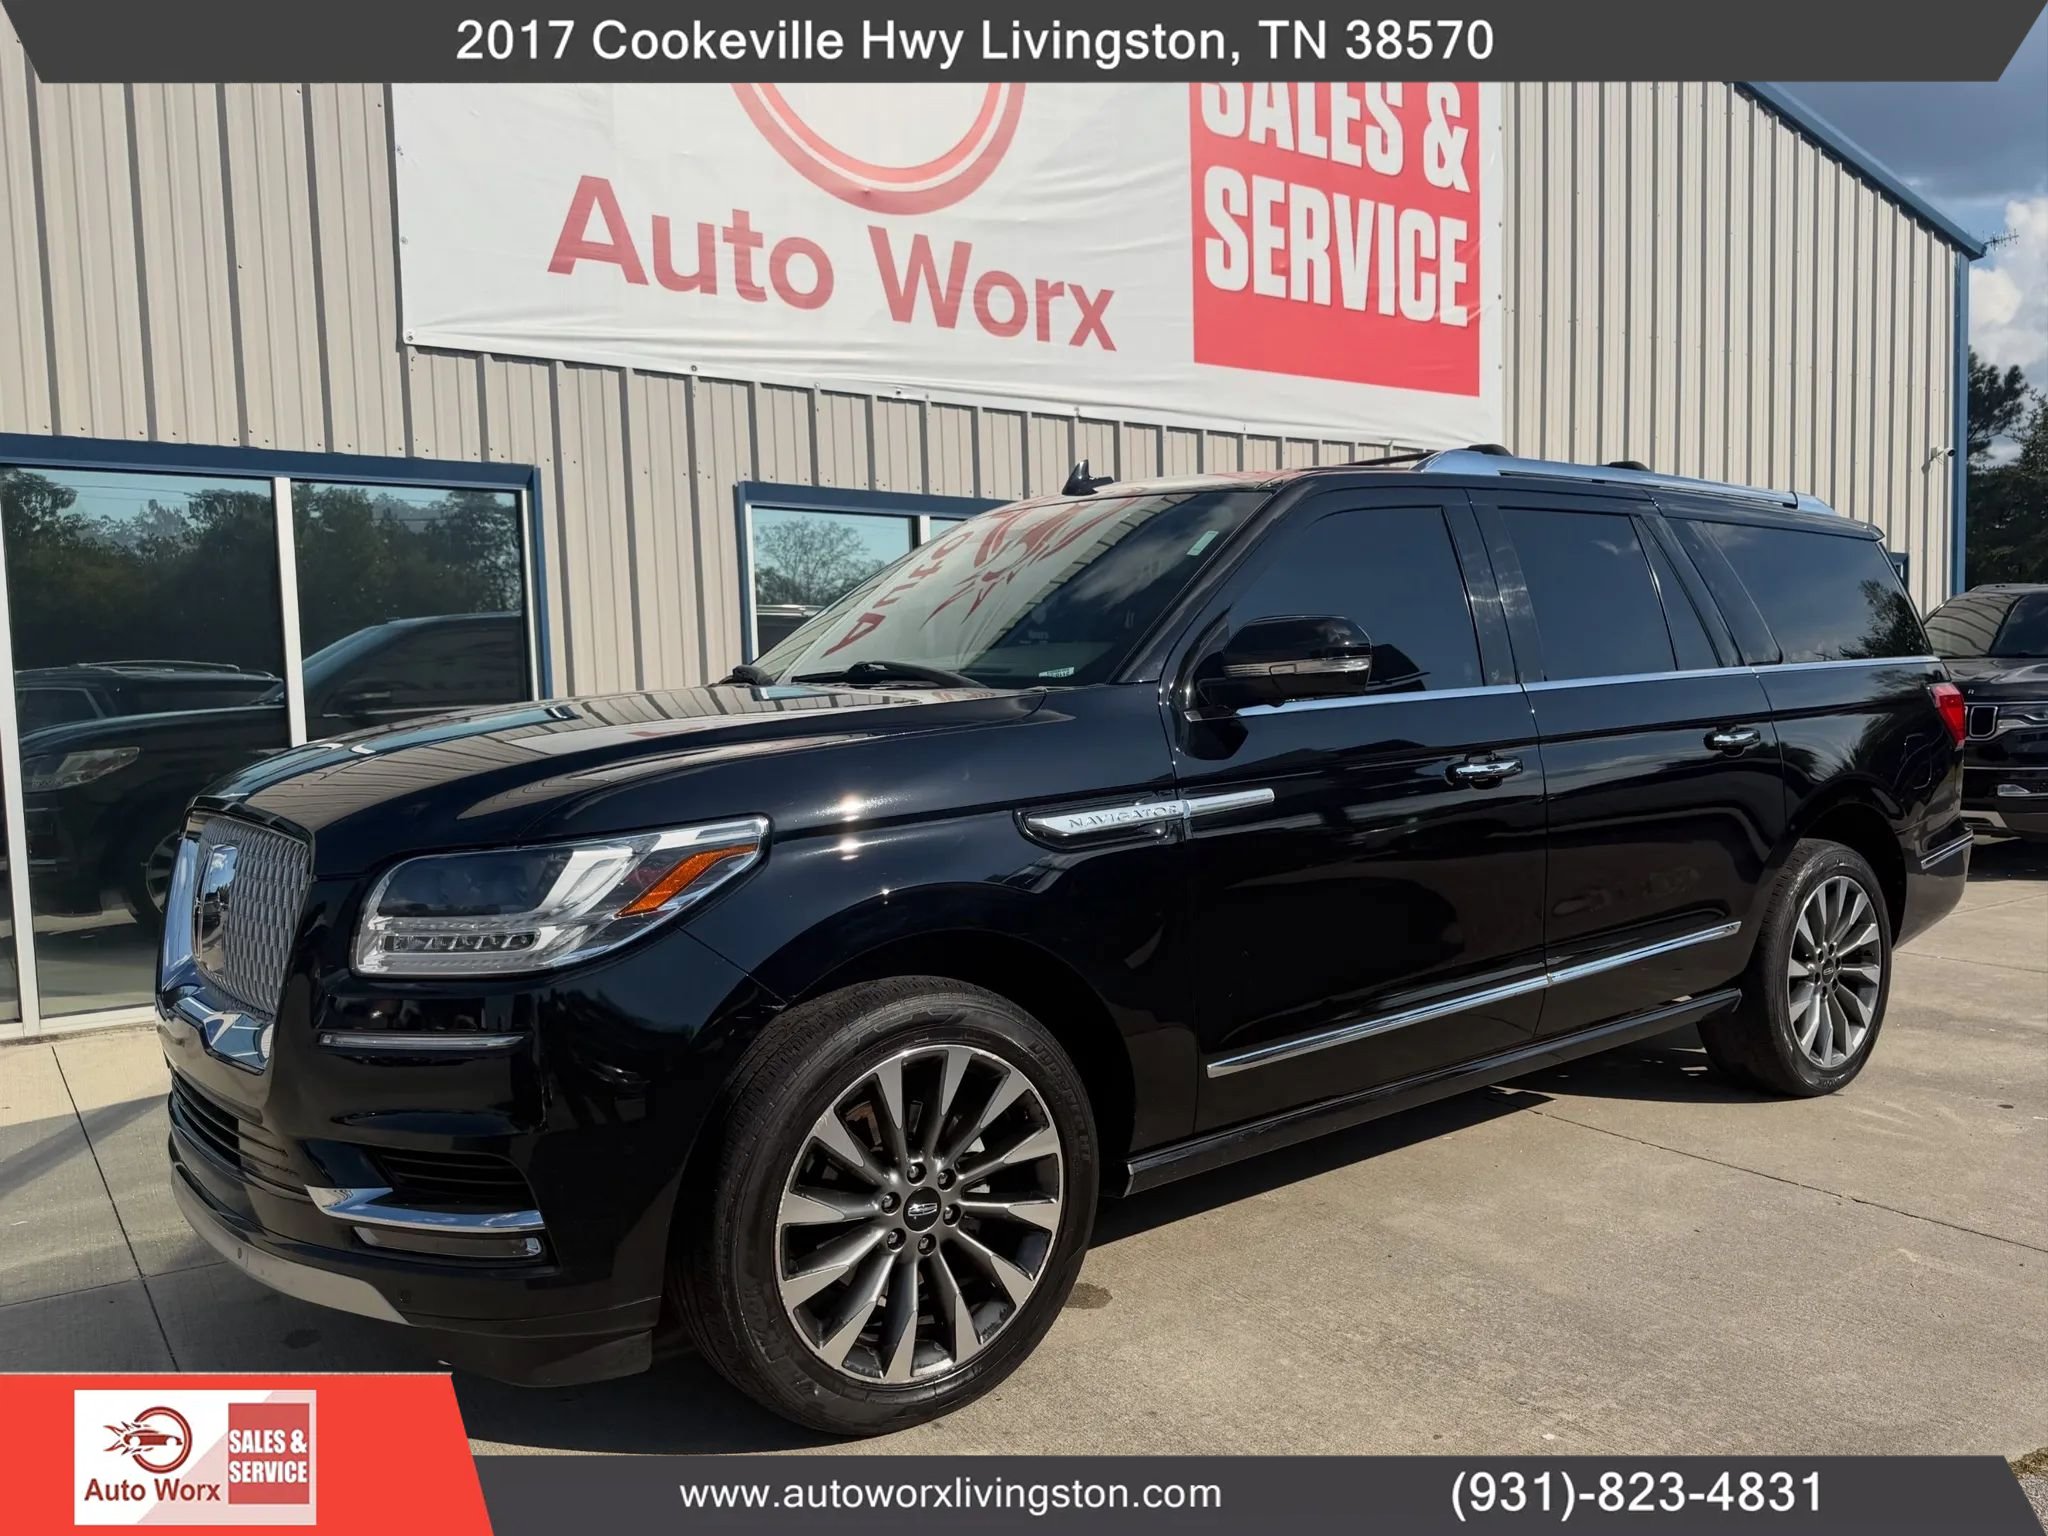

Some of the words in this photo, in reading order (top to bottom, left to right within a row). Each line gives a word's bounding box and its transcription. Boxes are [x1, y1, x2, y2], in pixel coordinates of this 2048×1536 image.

[1201, 82, 1404, 176] SALES
[1423, 82, 1470, 193] &
[548, 175, 834, 309] Auto
[867, 225, 1117, 352] Worx
[1204, 165, 1467, 327] SERVICE
[1069, 805, 1177, 828] NAVIGATOR
